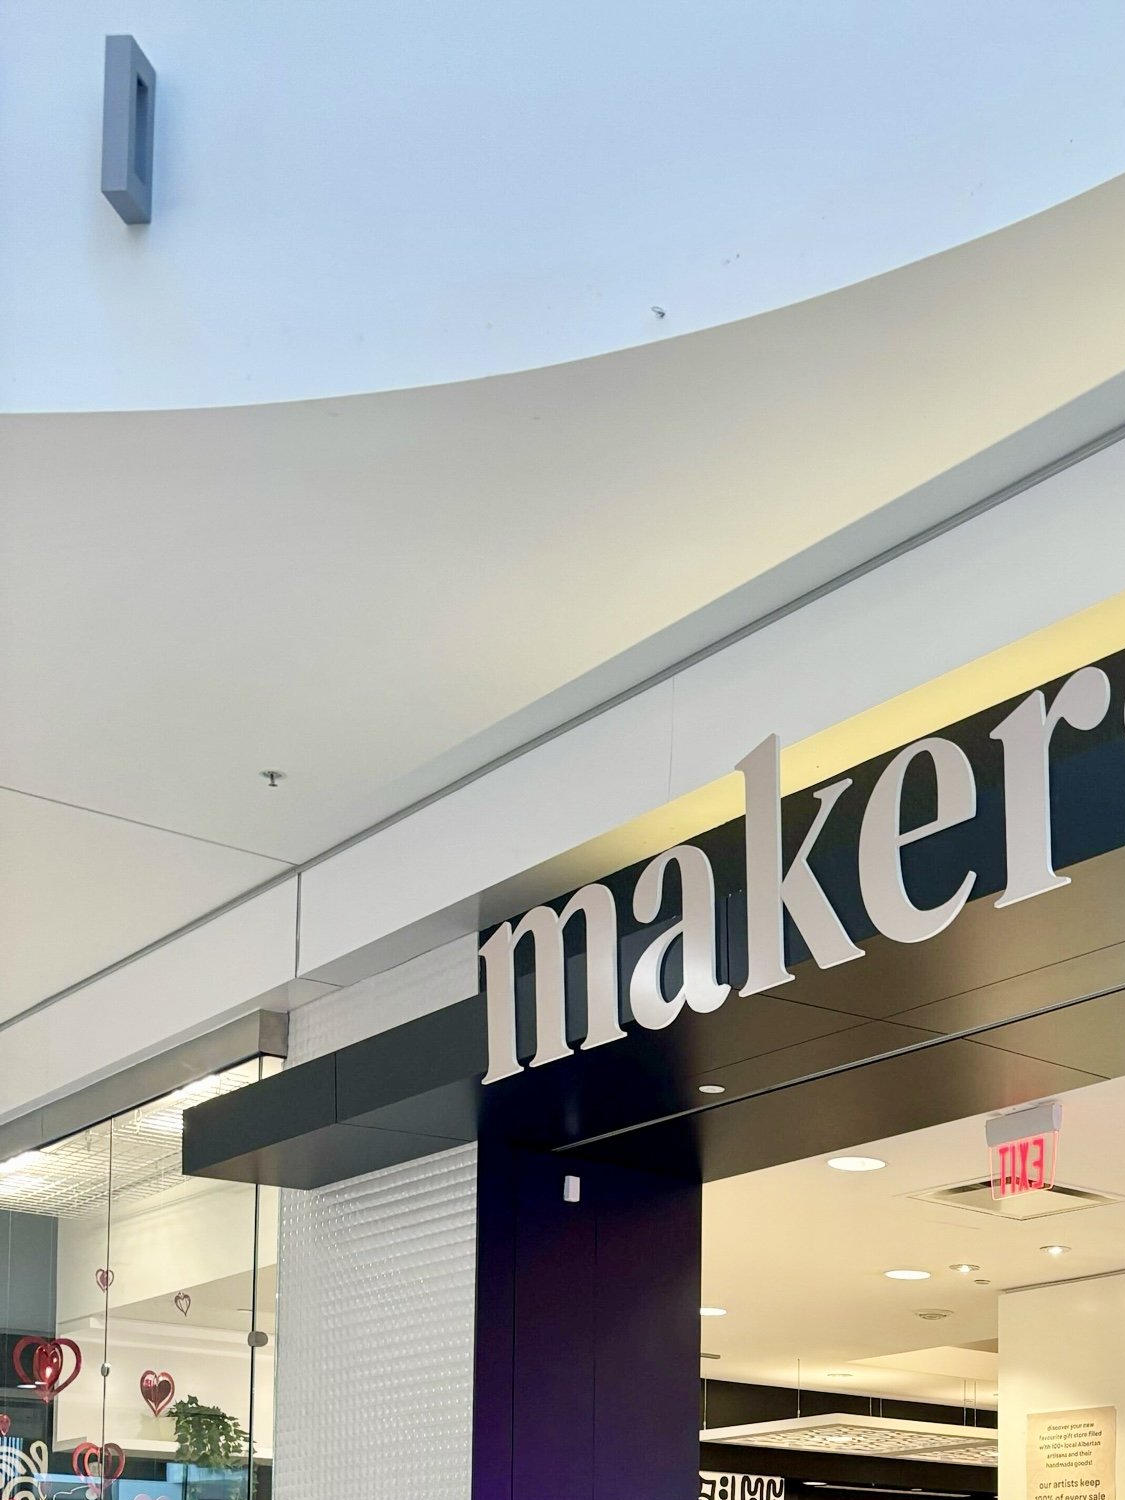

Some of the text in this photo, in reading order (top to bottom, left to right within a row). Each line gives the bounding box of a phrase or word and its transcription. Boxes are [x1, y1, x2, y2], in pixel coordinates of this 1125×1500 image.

[1039, 1478, 1101, 1490] our artists keep
[1088, 1492, 1106, 1500] sale
